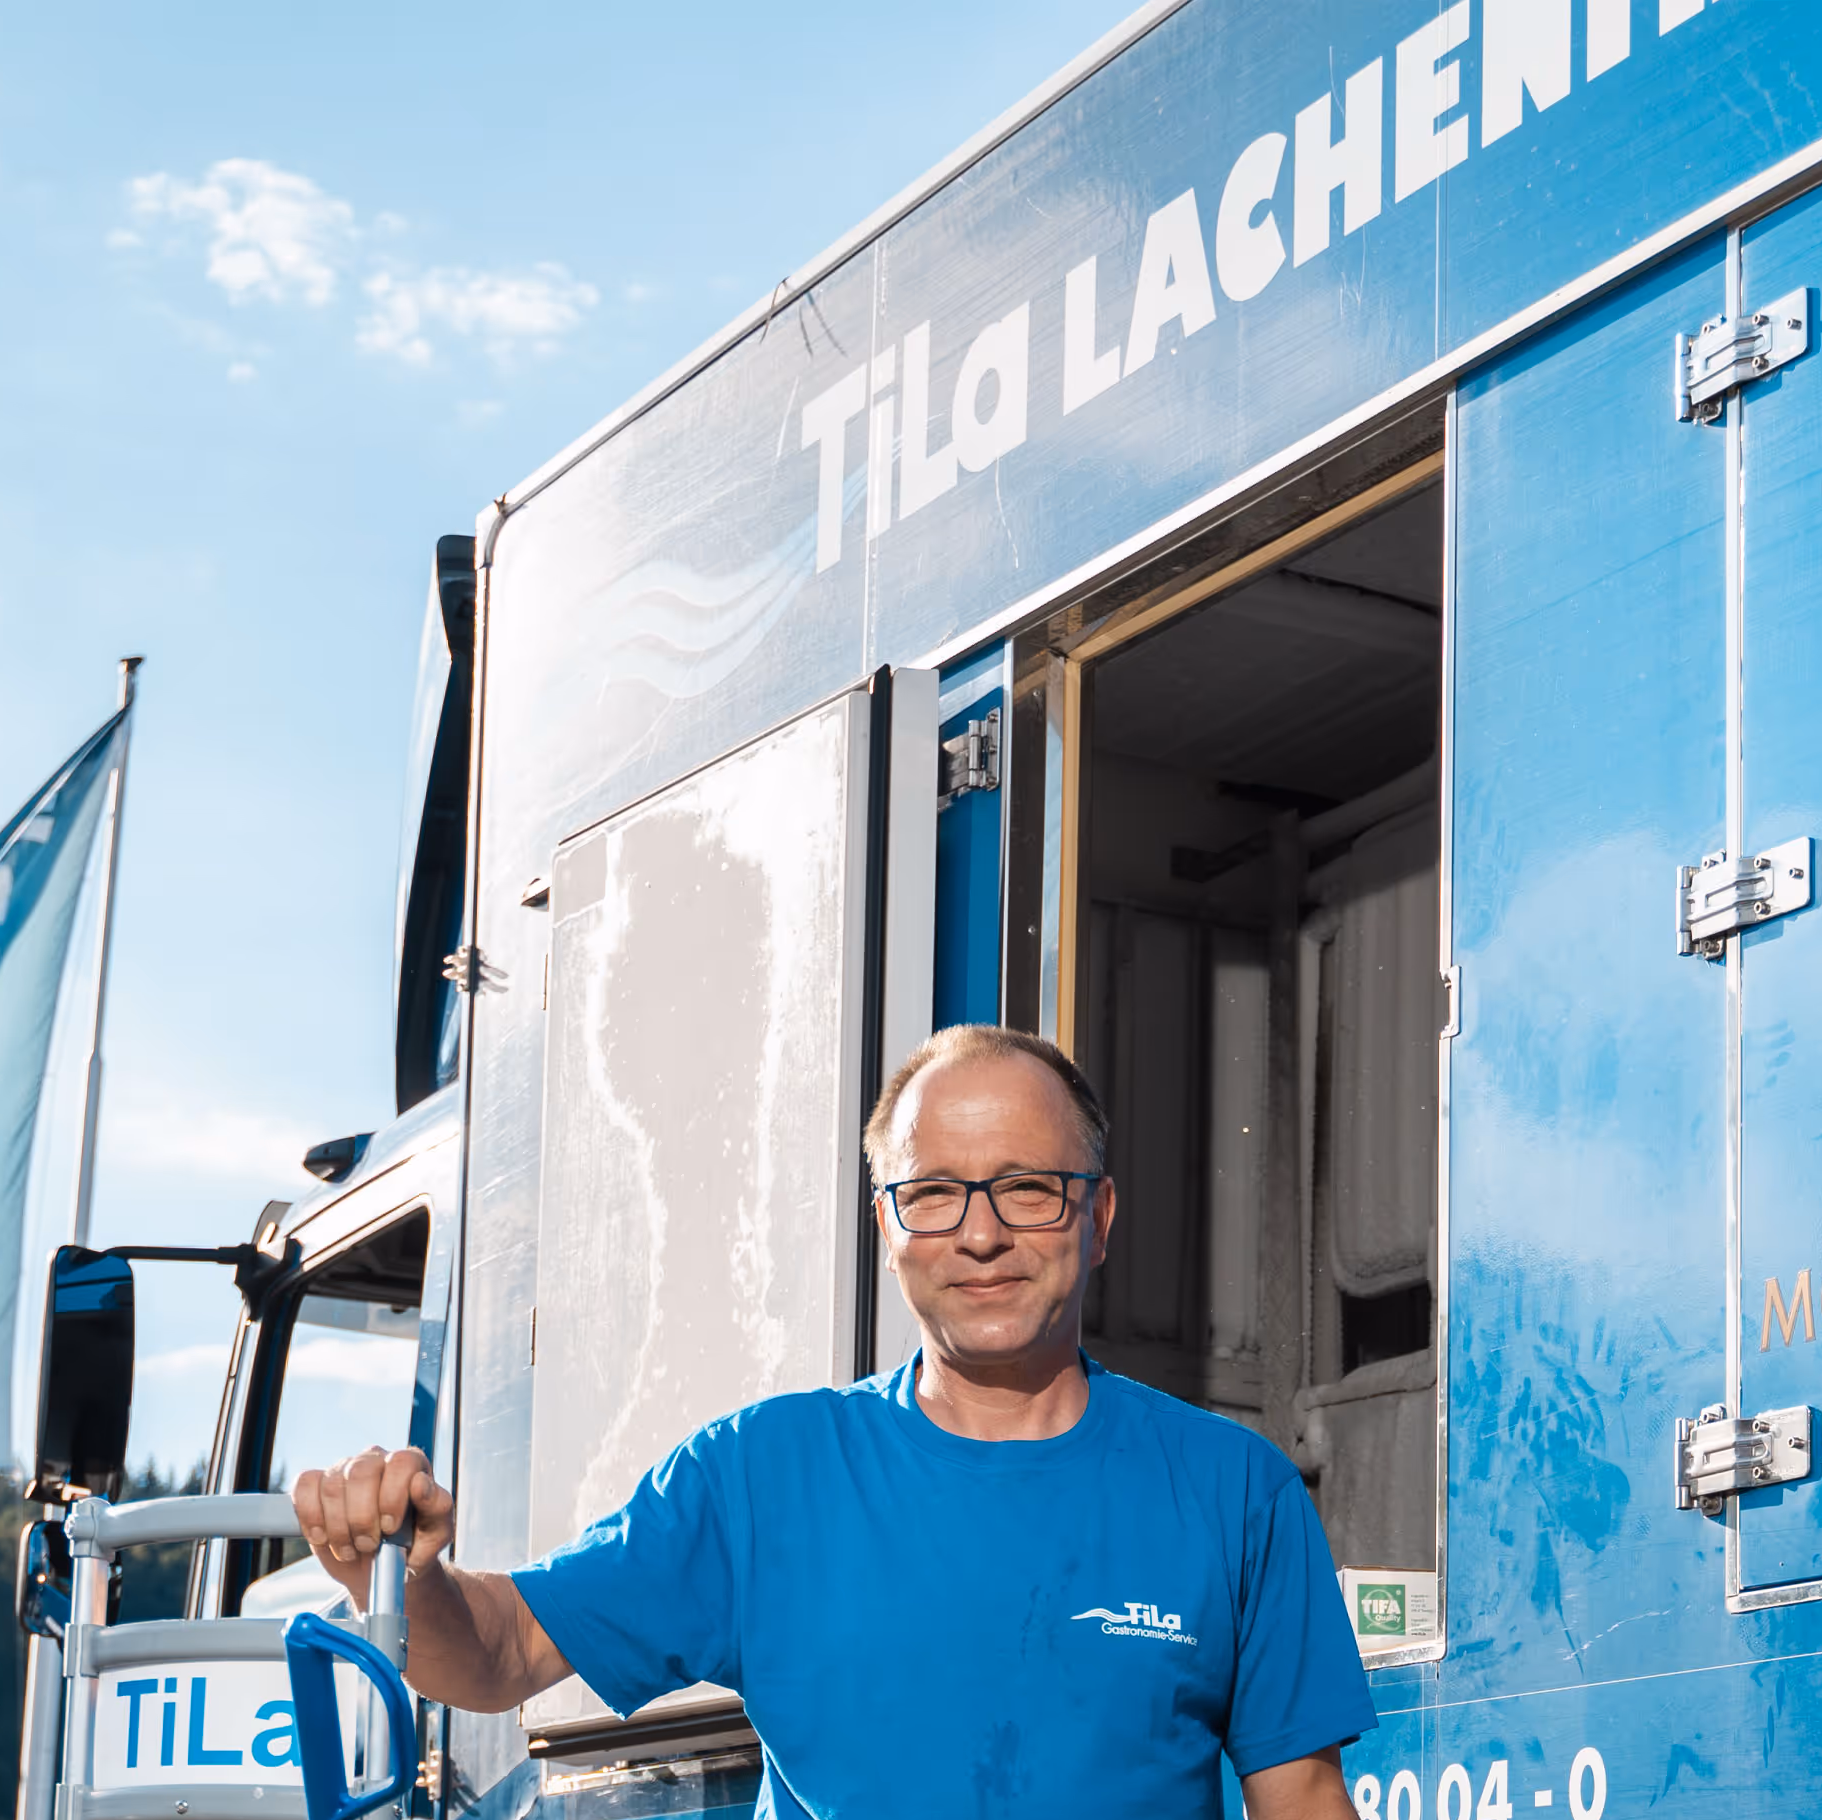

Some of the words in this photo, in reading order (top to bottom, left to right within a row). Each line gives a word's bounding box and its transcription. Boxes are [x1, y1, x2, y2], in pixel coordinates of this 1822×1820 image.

[801, 302, 1032, 576] TiLa
[1124, 1602, 1182, 1631] TiLa
[1361, 1599, 1401, 1615] TIFA
[1101, 1621, 1198, 1646] Gastronomie-Service
[115, 1676, 303, 1770] TiLa
